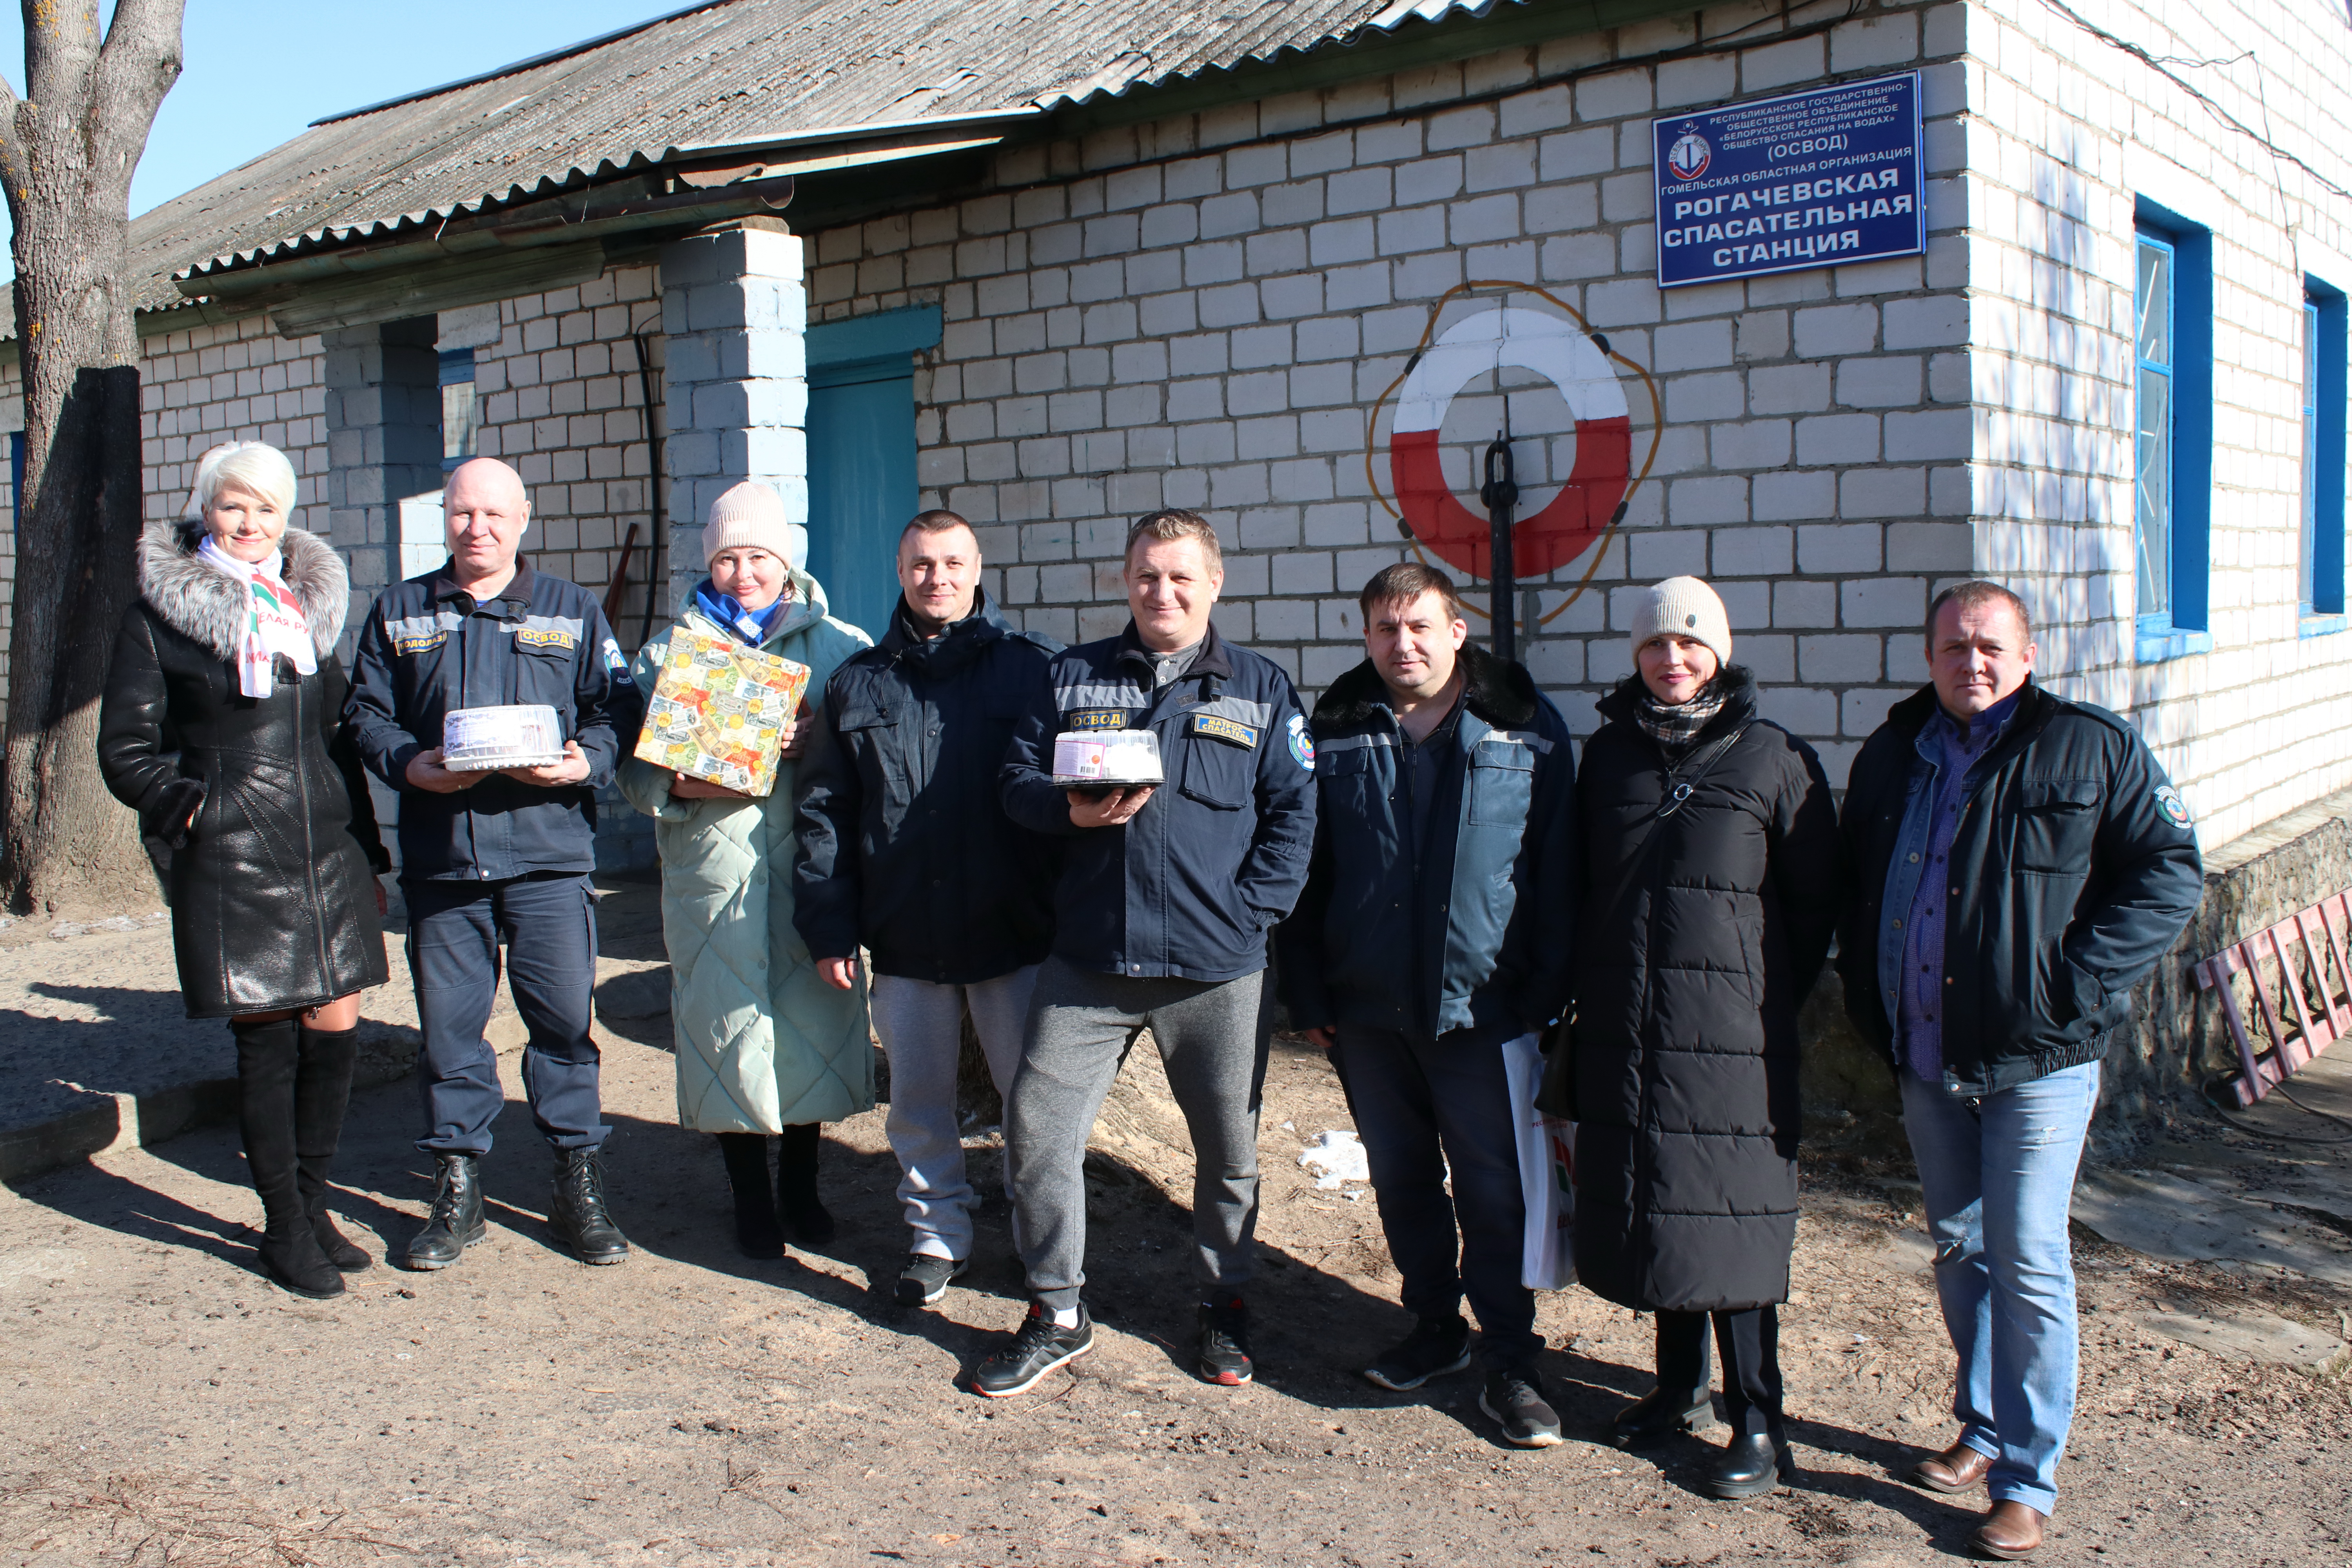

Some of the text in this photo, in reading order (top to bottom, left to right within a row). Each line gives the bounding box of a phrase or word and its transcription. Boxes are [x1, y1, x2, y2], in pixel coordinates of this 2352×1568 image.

[1710, 83, 1907, 125] РЕСПУБЛИКАНСКОЕ ГОСУДАРСТВЕННО-
[1727, 95, 1889, 131] ОБЩЕСТВЕННОЕ ОБЪЕДИНЕНИЕ
[1719, 103, 1898, 142] «БЕЛОРУССКОЕ РЕСПУБЛИКАНСКОЕ
[1722, 115, 1895, 150] ОБЩЕСТВО СПАСАНИЯ НА ВОДАХ»
[1768, 134, 1848, 162] (ОСВОД)
[1661, 146, 1912, 196] ГОМЕЛЬСКАЯ ОБЛАСТНАЯ ОРГАНИЗАЦИЯ
[1675, 168, 1898, 220] РОГАЧЕВСКАЯ
[1664, 194, 1913, 248] СПАСАТЕЛЬНАЯ
[1713, 229, 1860, 267] СТАНЦИЯ
[259, 612, 289, 627] ЕЛАЯ
[399, 635, 443, 650] ВОДОЛАЗ
[522, 631, 569, 646] ОСВОД
[1073, 713, 1121, 727] ОСВОД
[1202, 724, 1250, 742] СПАСАТЕЛЬ
[1208, 719, 1246, 733] МАТРОС-
